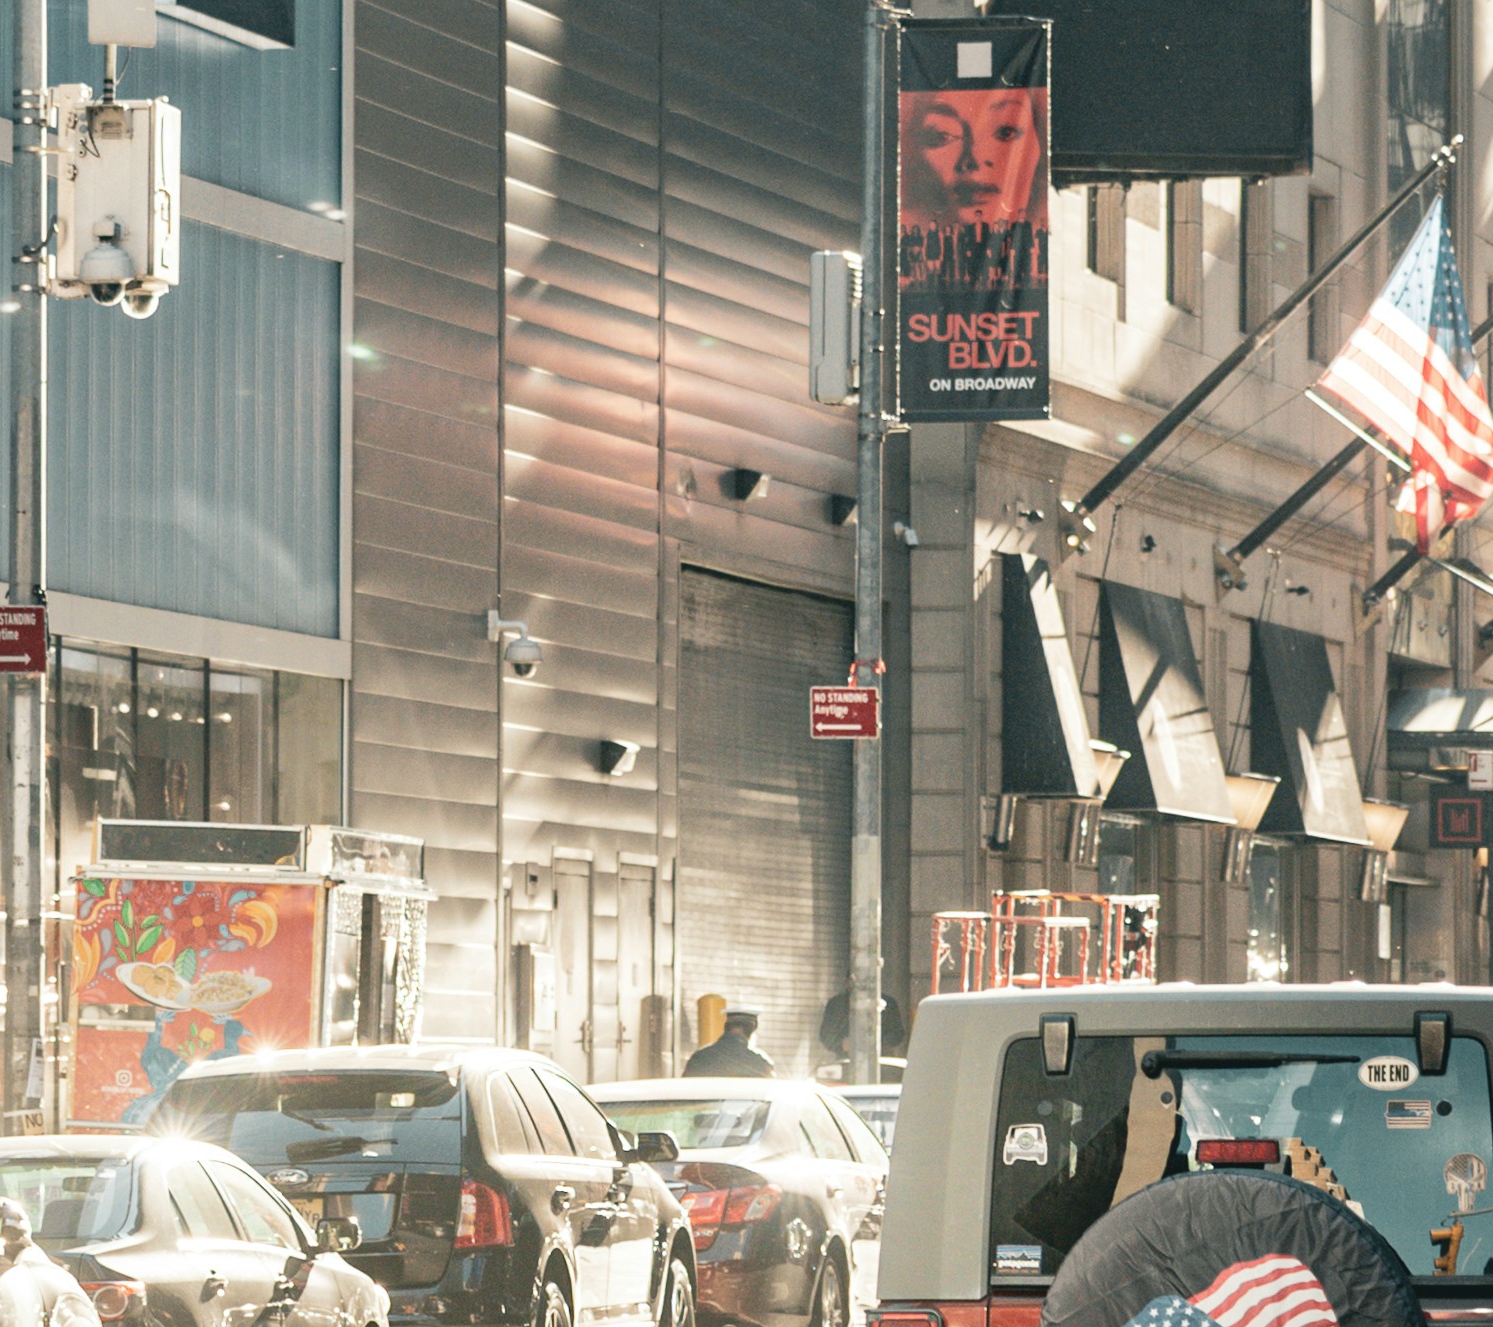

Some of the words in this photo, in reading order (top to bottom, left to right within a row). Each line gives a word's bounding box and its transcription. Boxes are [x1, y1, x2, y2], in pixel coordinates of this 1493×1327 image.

[908, 312, 1039, 344] SUNSET
[948, 340, 1037, 370] BLVD.
[929, 378, 951, 392] ON
[954, 376, 1037, 392] BROADWAY
[0, 613, 37, 627] STANDING
[814, 694, 827, 705] NO
[828, 693, 869, 705] STANDING
[814, 705, 850, 718] Anytime
[1367, 1064, 1387, 1083] THE
[1388, 1064, 1410, 1083] END
